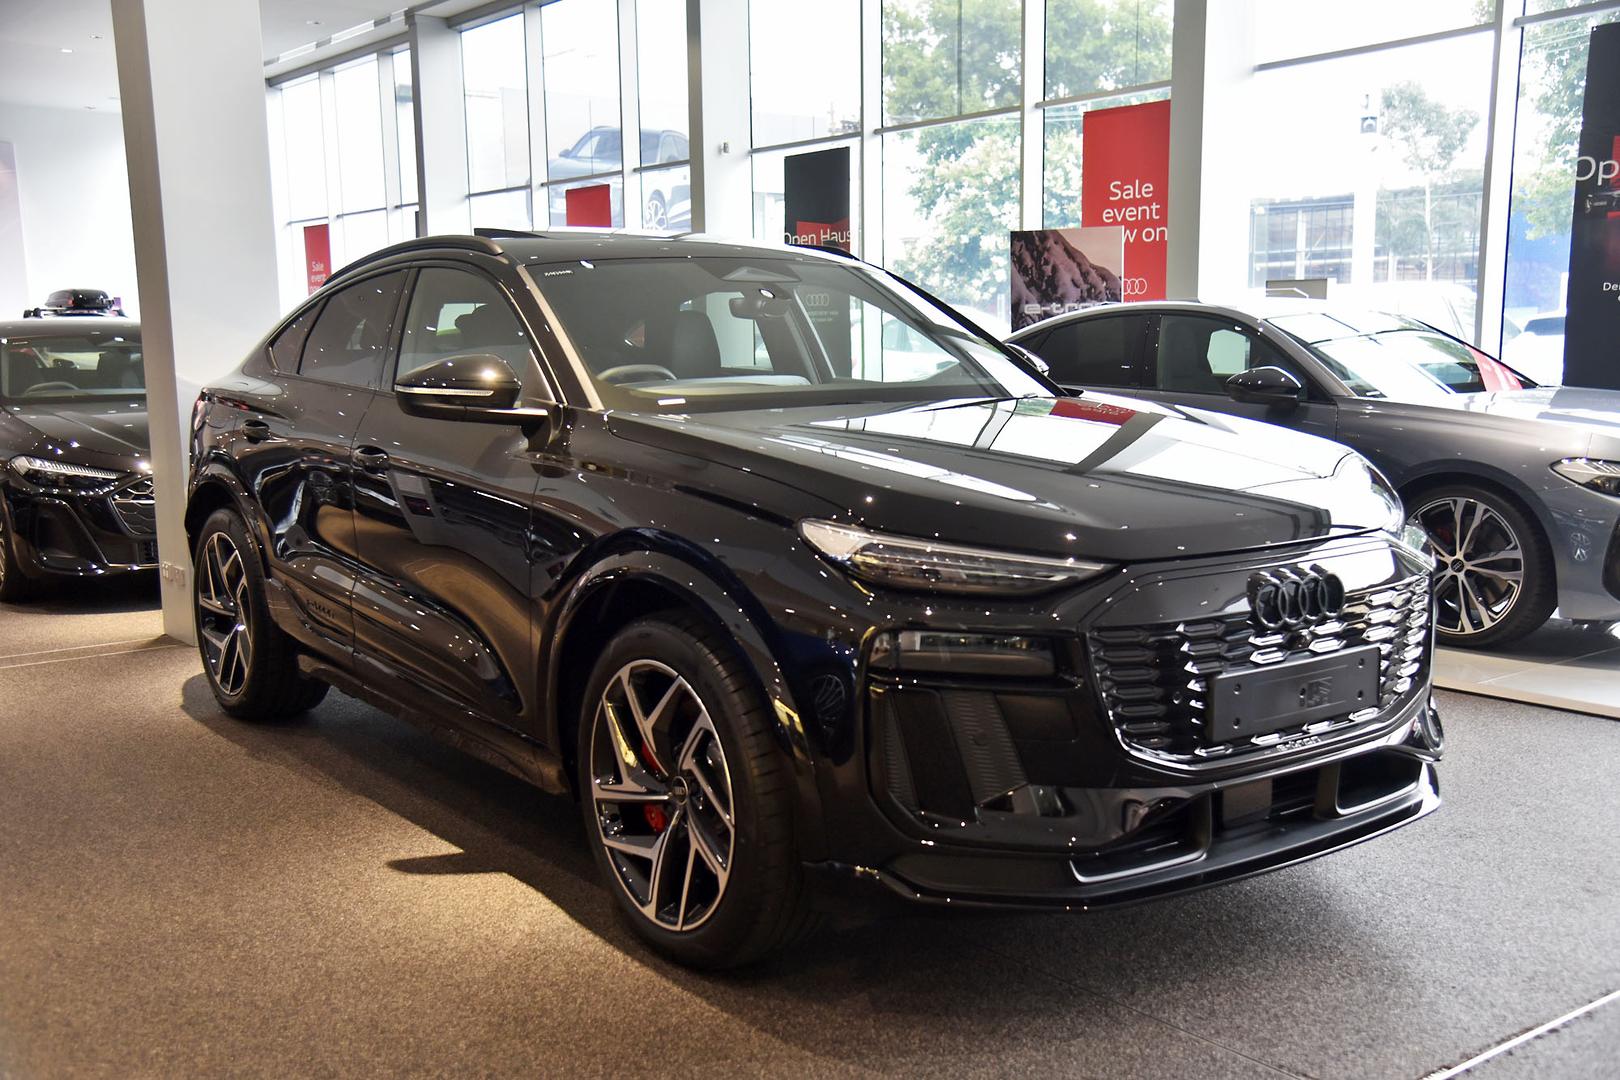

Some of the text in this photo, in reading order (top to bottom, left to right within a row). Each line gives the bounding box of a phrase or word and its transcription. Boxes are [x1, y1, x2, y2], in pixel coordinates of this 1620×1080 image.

[1109, 179, 1154, 201] Sale
[1102, 202, 1161, 223] event
[1142, 226, 1168, 242] on
